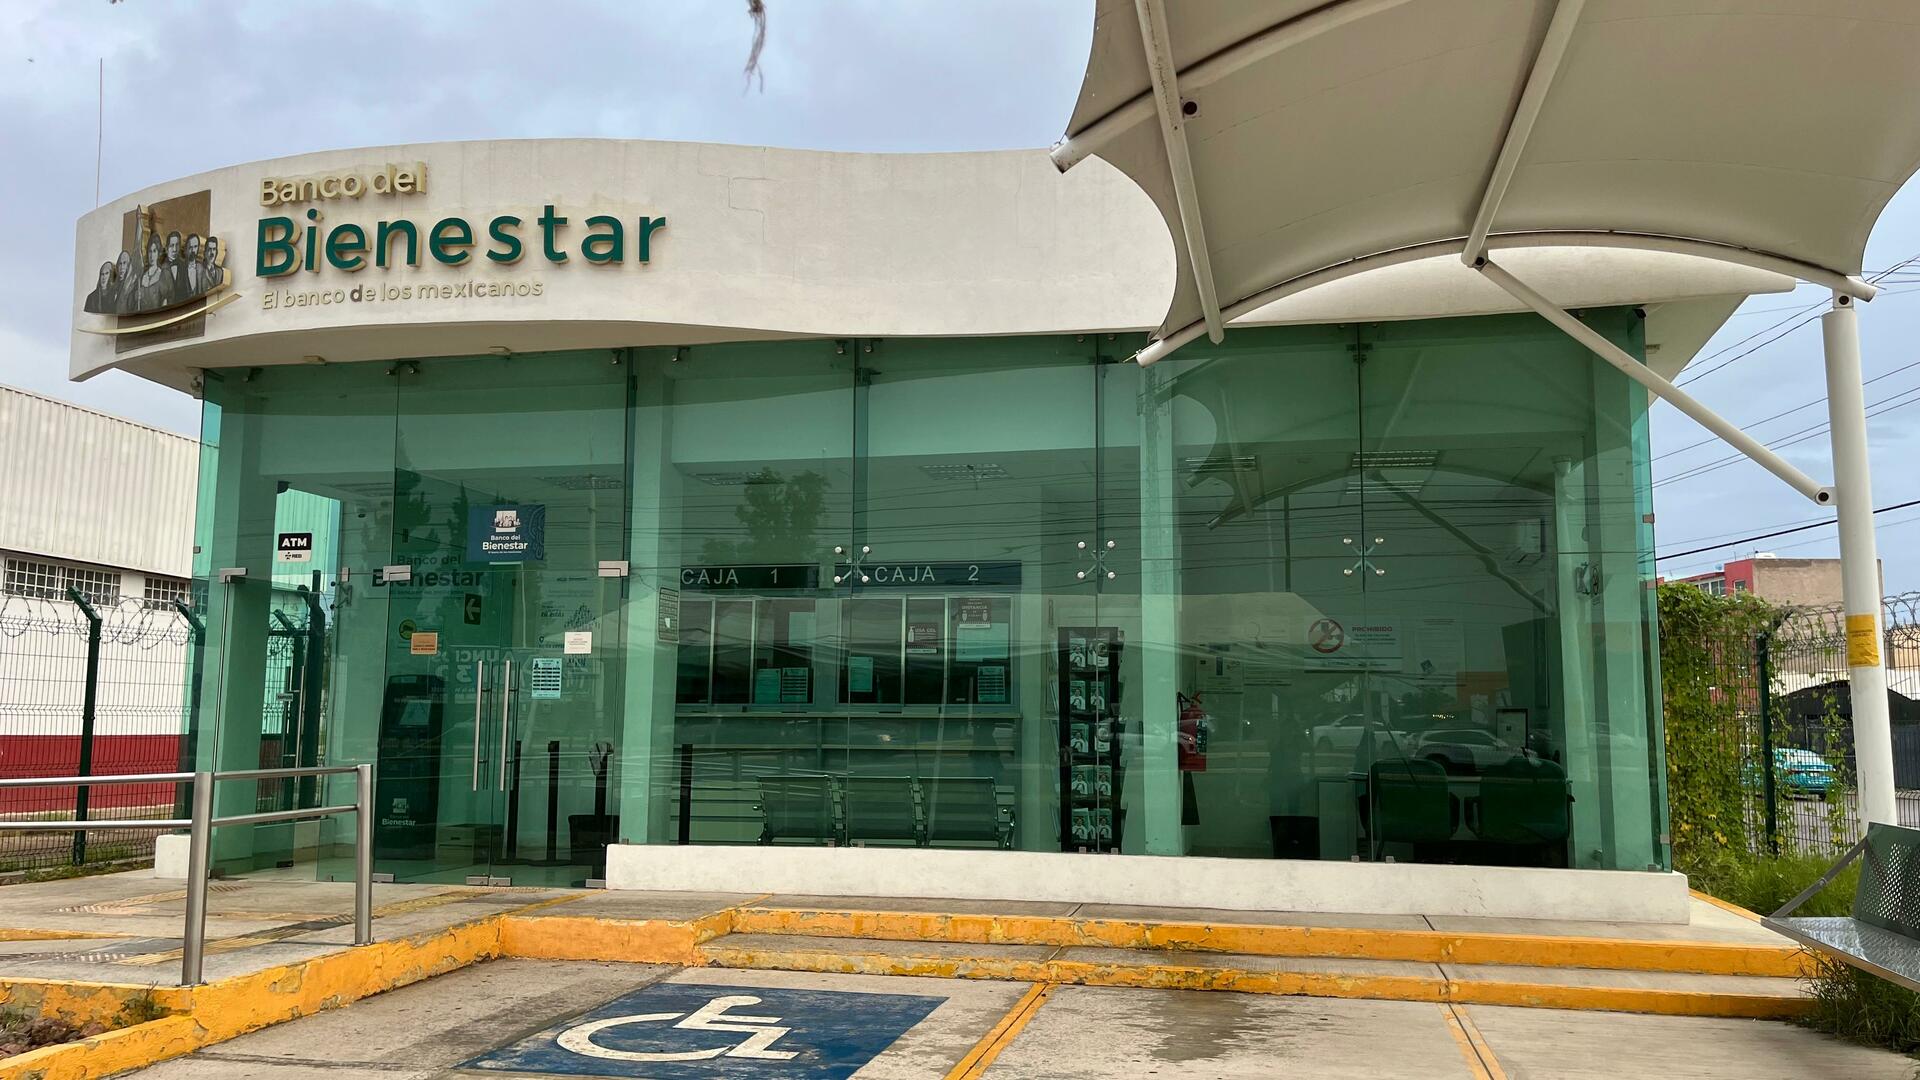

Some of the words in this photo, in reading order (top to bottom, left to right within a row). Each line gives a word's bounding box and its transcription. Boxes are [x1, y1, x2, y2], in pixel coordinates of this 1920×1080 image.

[260, 172, 367, 207] Banco
[371, 161, 427, 195] del
[256, 204, 667, 278] Bienestar
[262, 290, 280, 310] El
[283, 289, 345, 308] banco
[350, 284, 377, 303] de
[381, 282, 412, 301] los
[417, 279, 544, 300] mexicanos
[281, 537, 307, 547] ATM
[482, 541, 528, 550] Bienestar
[681, 568, 739, 585] CAJA
[770, 568, 778, 584] 1
[874, 566, 936, 583] CAJA
[968, 565, 980, 582] 2
